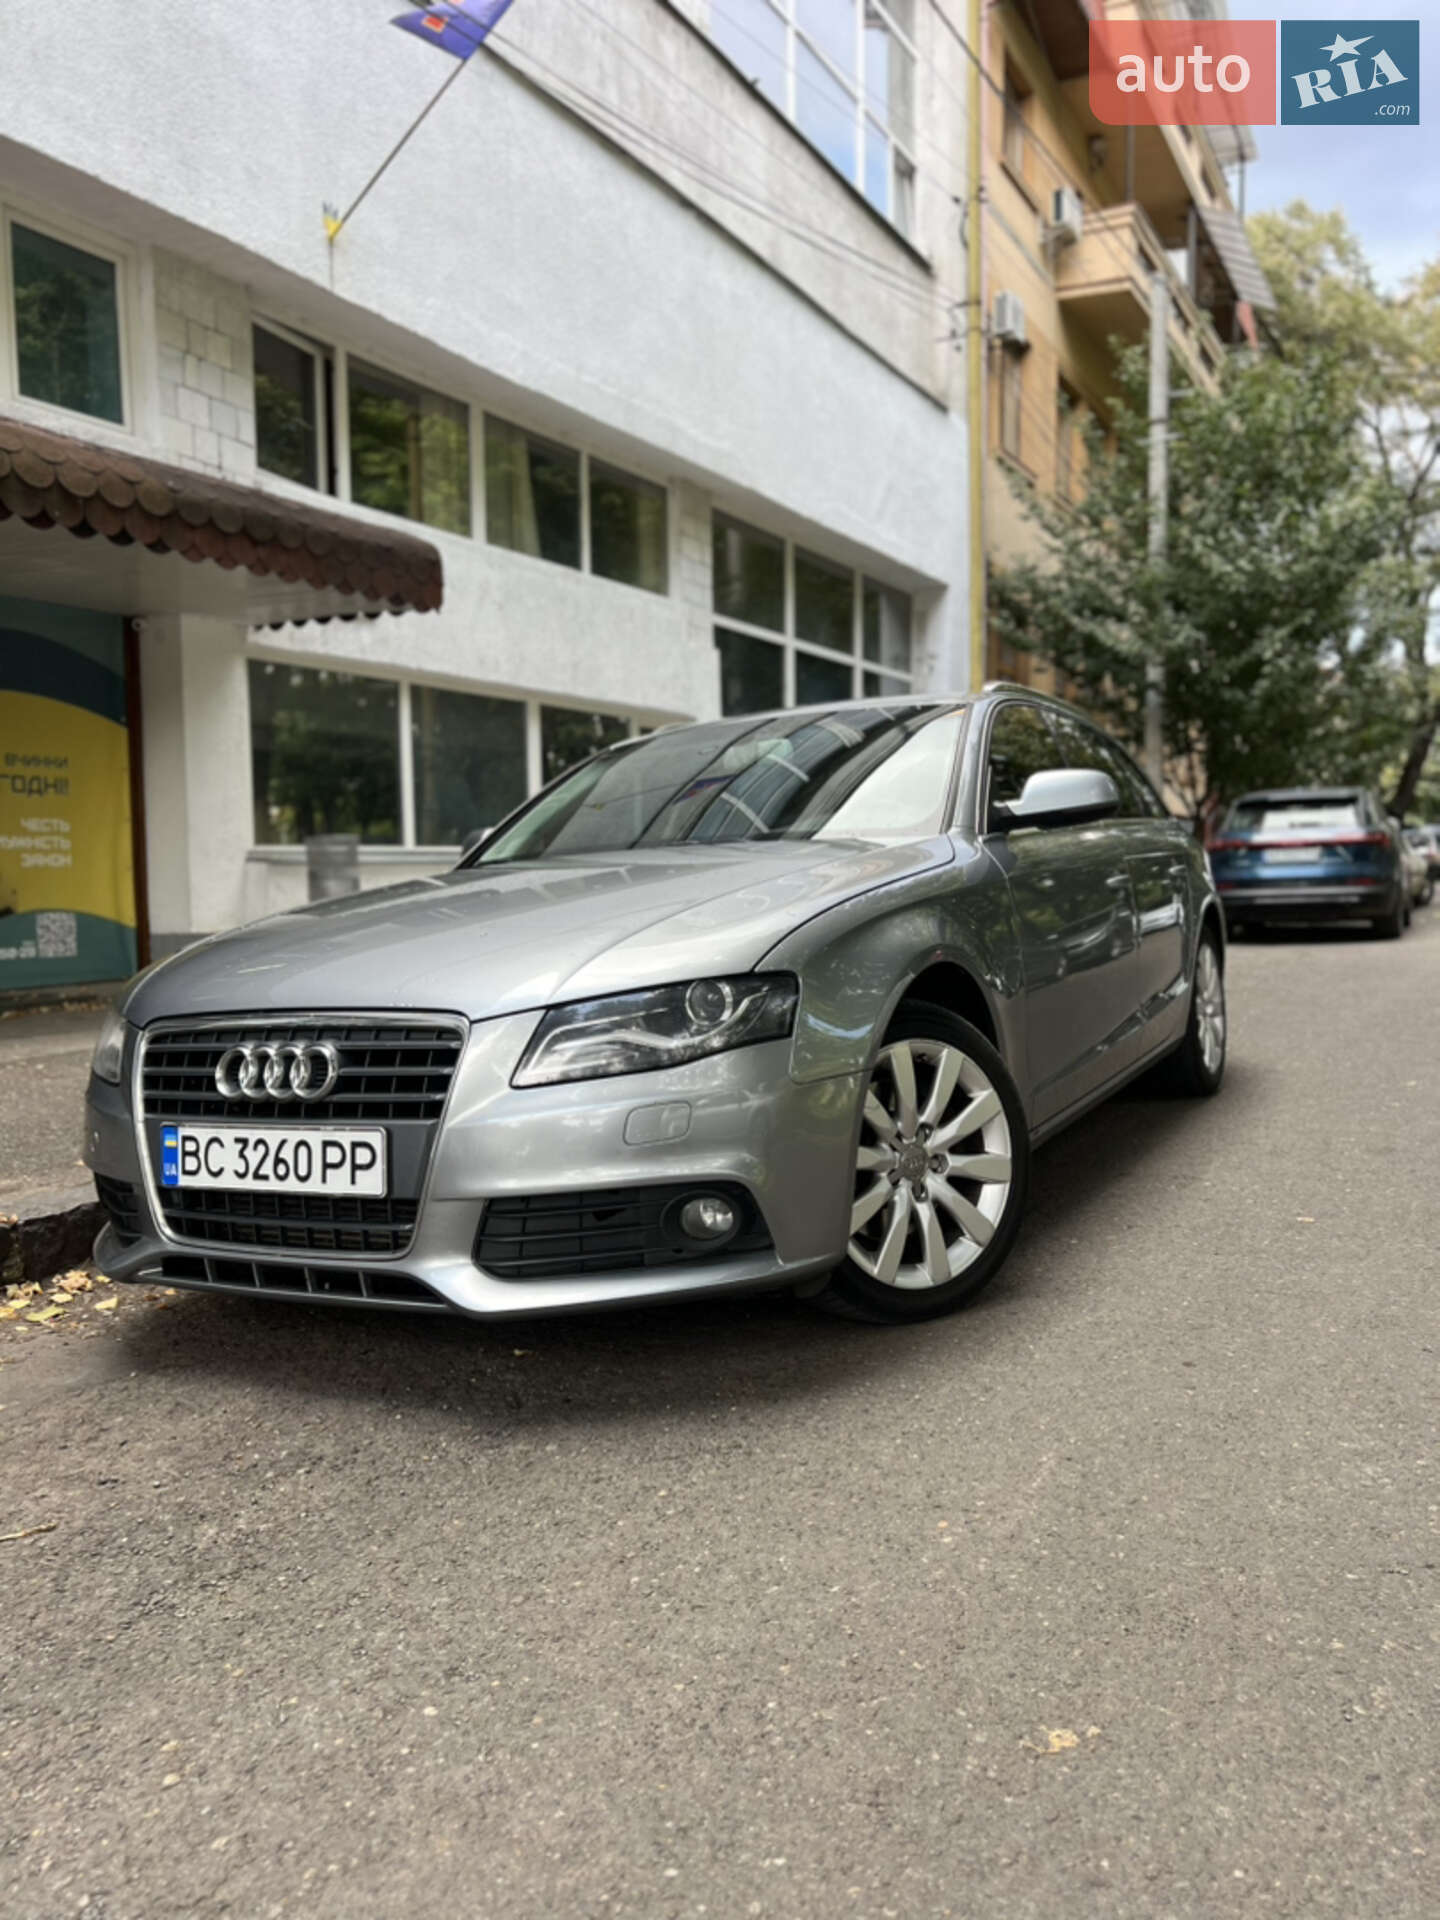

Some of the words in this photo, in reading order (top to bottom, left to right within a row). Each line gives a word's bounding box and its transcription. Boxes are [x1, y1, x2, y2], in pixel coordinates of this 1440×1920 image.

[20, 816, 71, 833] ЧЕСТЬ
[233, 1137, 313, 1184] 3260
[164, 1162, 178, 1177] UA
